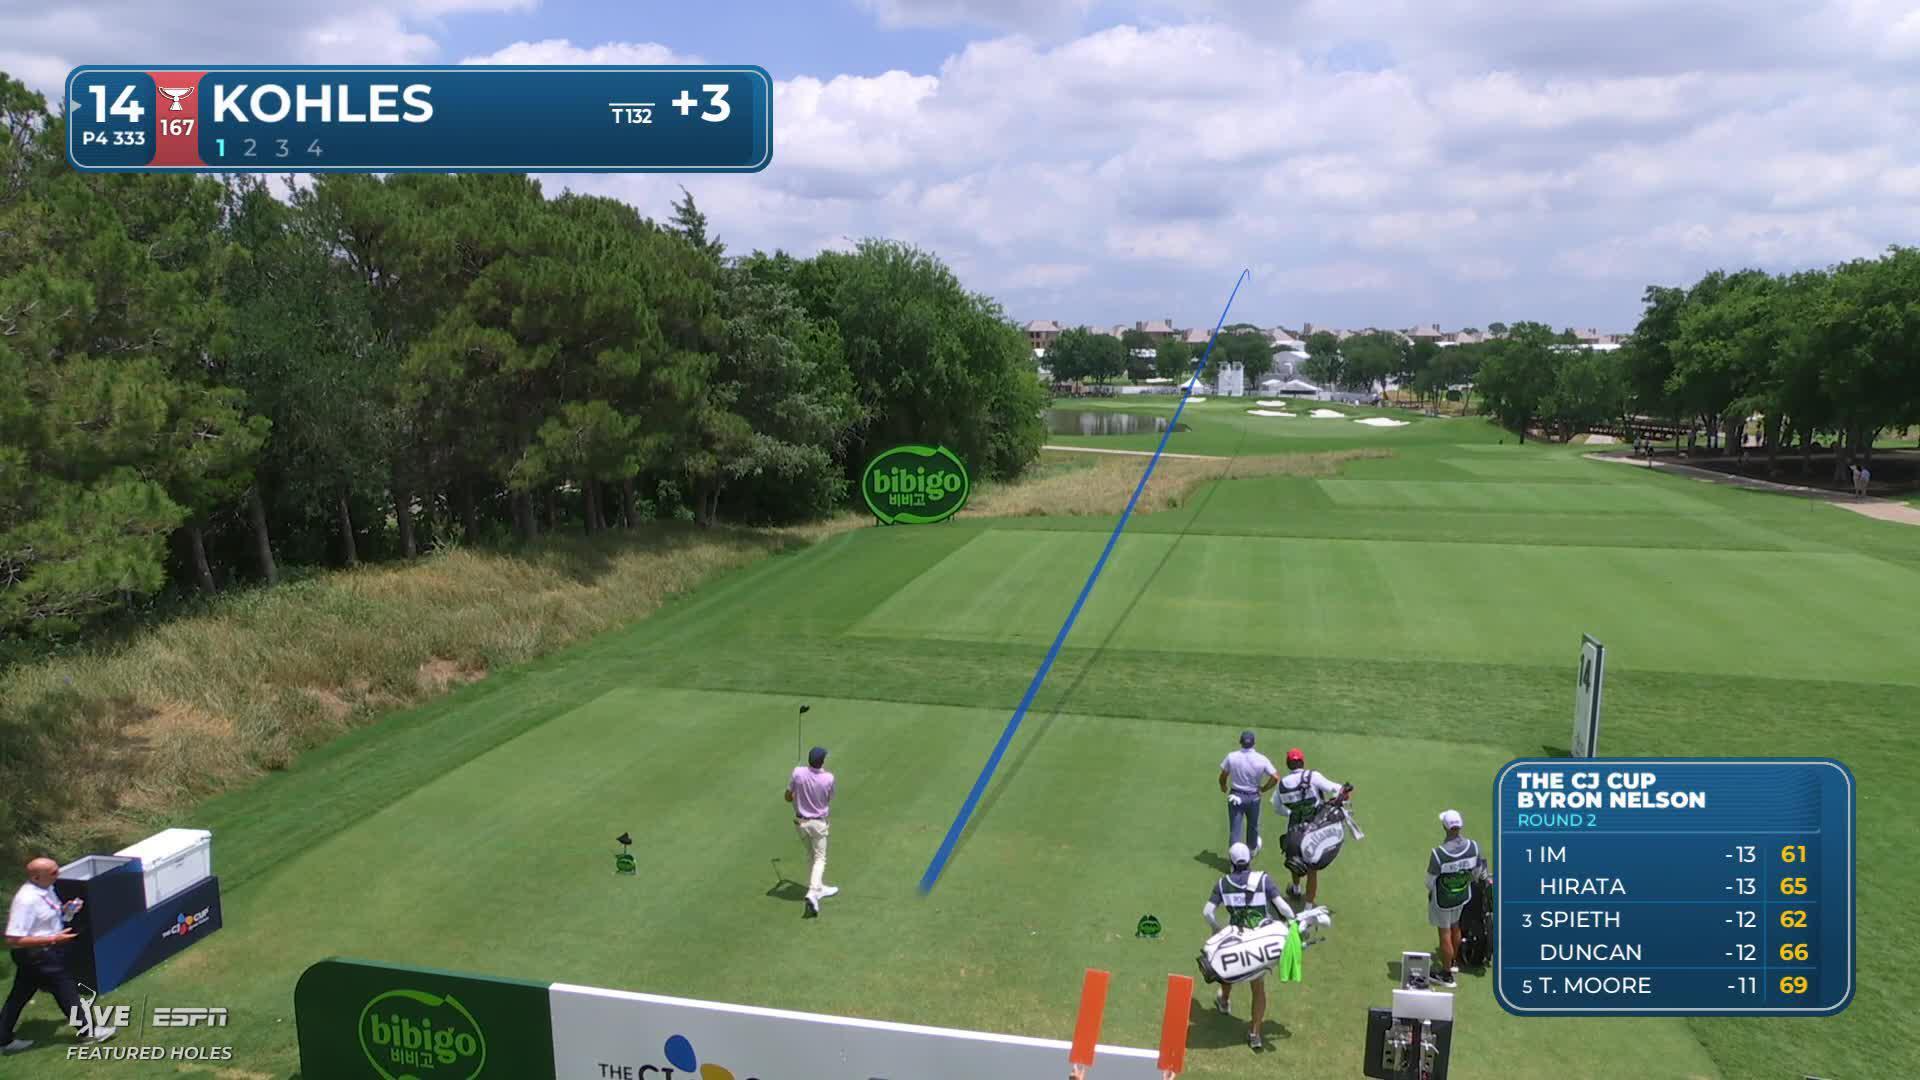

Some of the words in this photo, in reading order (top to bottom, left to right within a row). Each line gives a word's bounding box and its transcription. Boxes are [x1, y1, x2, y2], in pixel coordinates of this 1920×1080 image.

[873, 466, 961, 500] bibigo
[1579, 653, 1592, 693] 14
[1220, 941, 1282, 972] PING
[371, 1013, 477, 1064] bibigo
[390, 1047, 435, 1069] 비비고
[598, 1063, 633, 1080] THE
